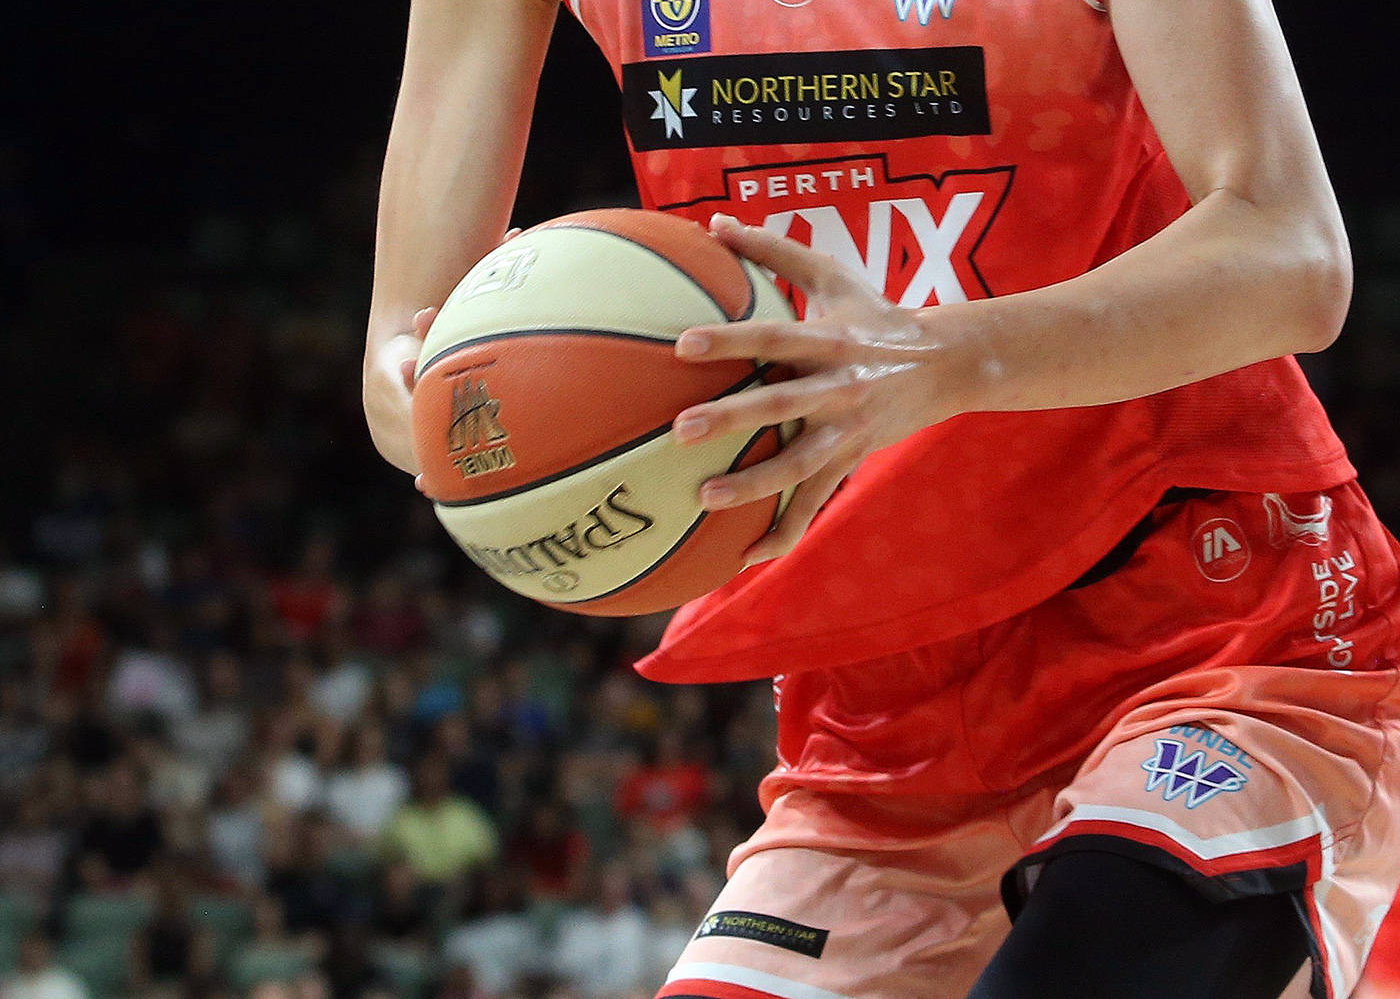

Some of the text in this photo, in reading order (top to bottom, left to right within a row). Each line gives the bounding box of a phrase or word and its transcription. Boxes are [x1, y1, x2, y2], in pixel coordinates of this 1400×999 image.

[654, 32, 700, 48] METRO
[711, 70, 959, 106] NORTHERN STAR
[711, 100, 964, 125] RESOURCES LTD
[738, 167, 876, 201] PERTH
[1331, 549, 1360, 619] LIVE
[721, 915, 785, 935] NORTHERN
[786, 927, 817, 941] STAR
